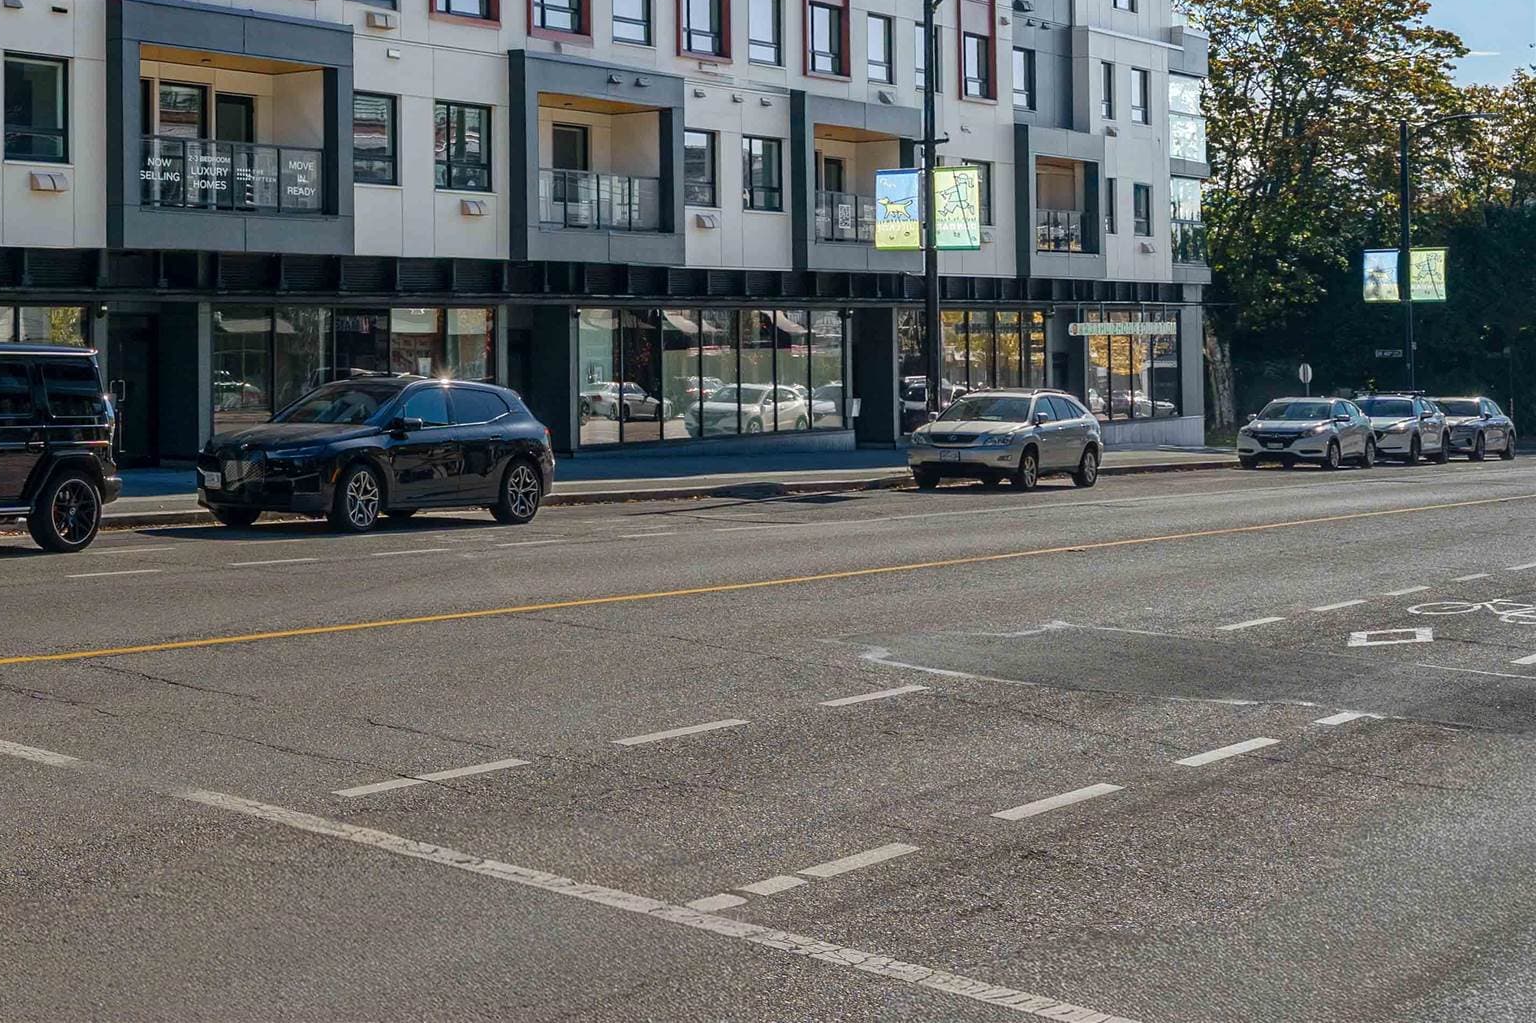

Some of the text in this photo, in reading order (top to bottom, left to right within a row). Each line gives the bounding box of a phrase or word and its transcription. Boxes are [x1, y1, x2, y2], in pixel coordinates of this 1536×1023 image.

[147, 158, 172, 167] NOW
[199, 155, 231, 164] BEDROOM
[288, 161, 314, 171] MOVE
[140, 170, 181, 182] SELLING
[191, 166, 229, 177] LUXURY
[193, 179, 227, 190] HOMES
[287, 186, 316, 196] READY
